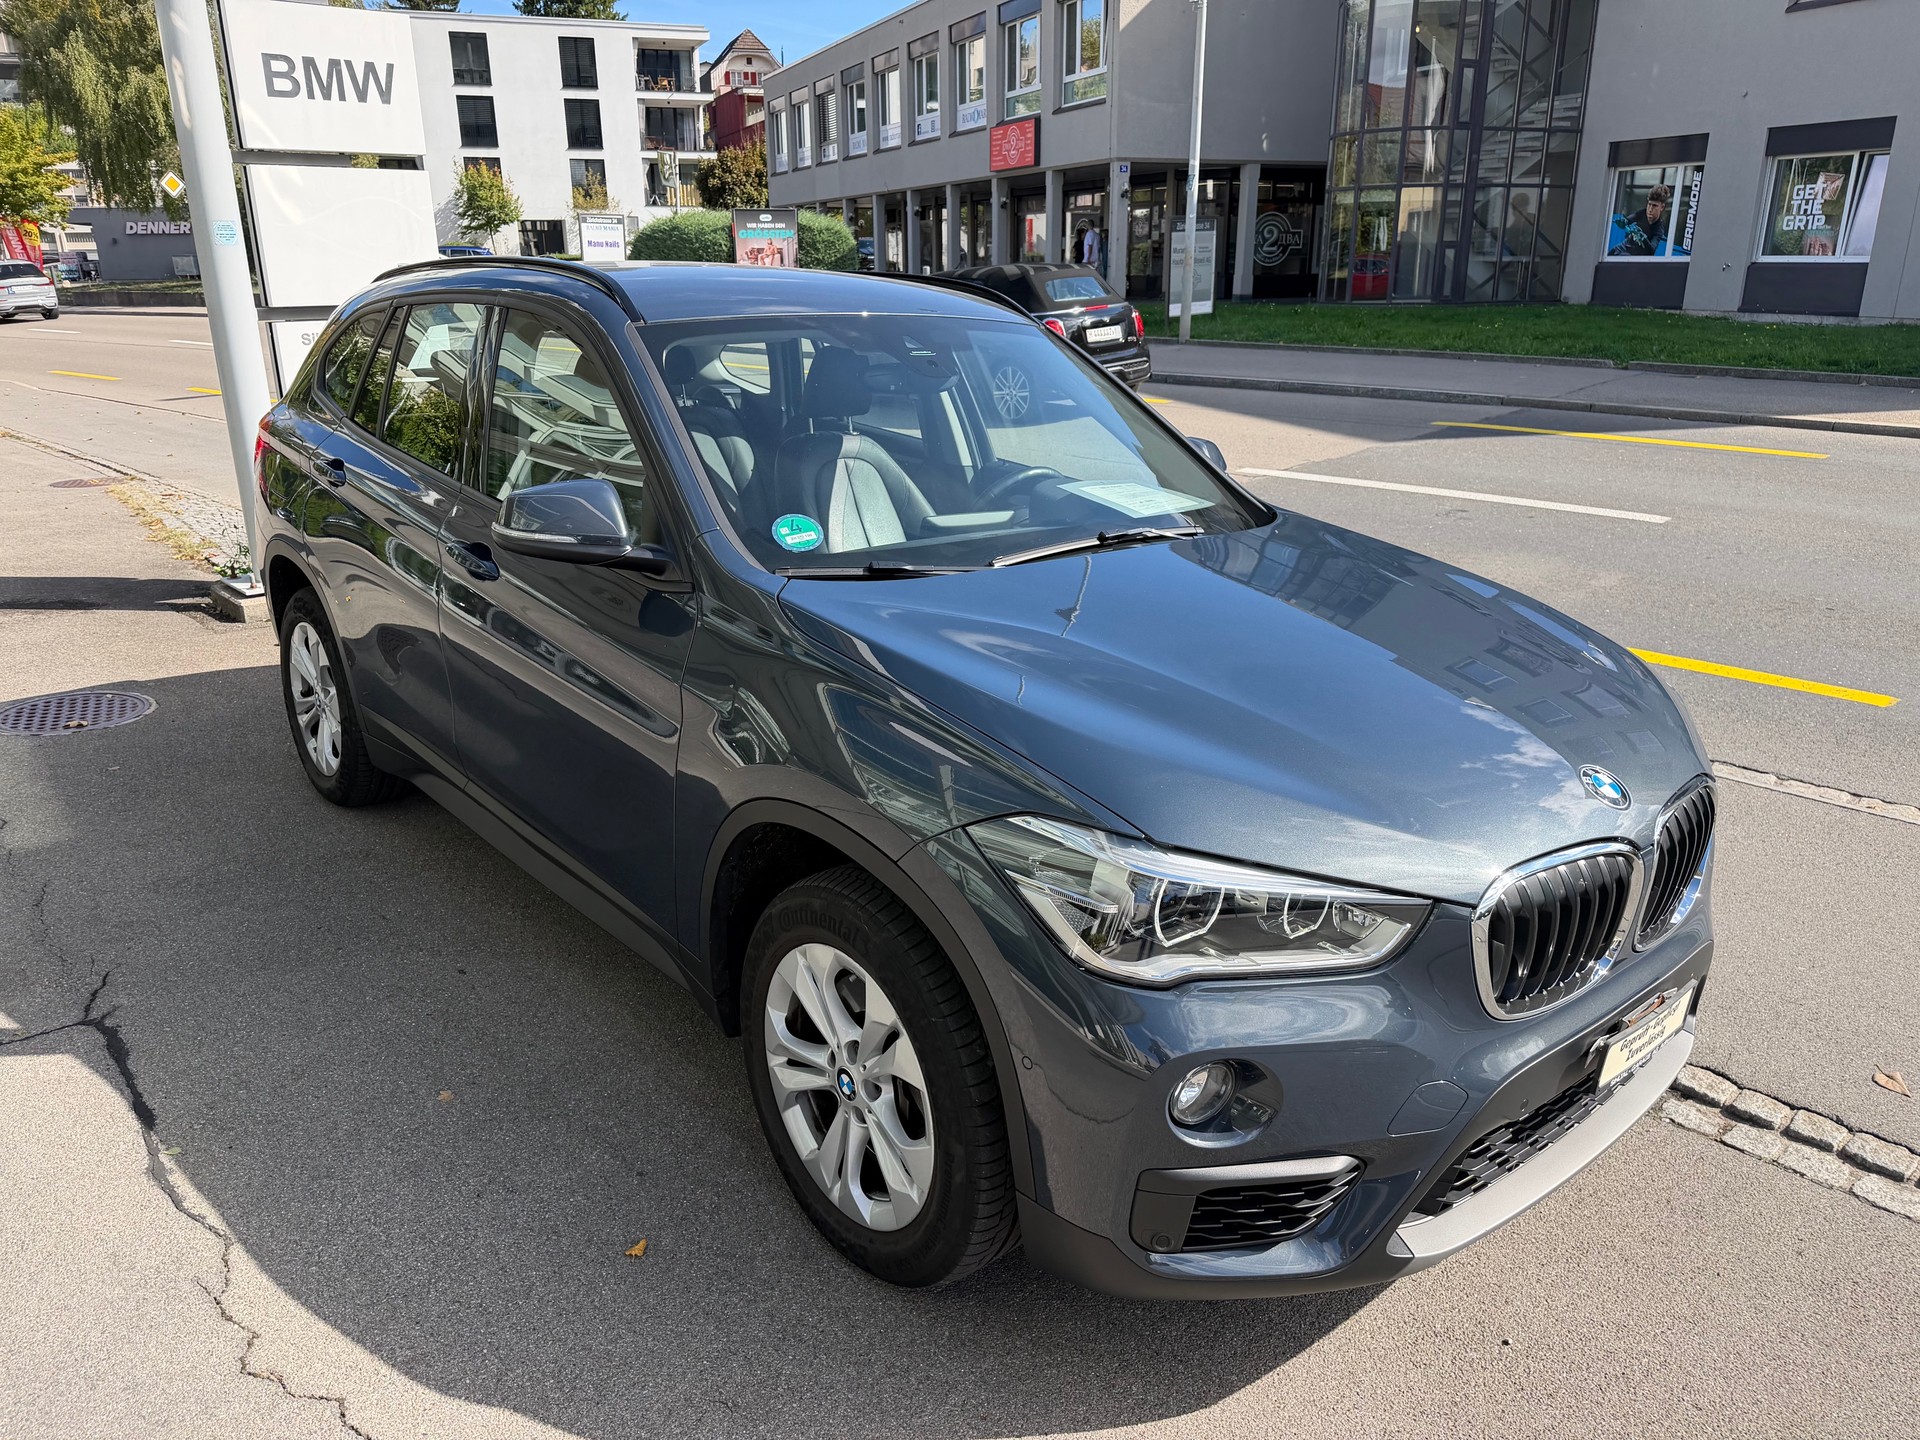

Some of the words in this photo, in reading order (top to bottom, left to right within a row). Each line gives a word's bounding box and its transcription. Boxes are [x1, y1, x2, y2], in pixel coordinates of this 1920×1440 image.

[261, 52, 394, 105] BMW
[1792, 184, 1827, 200] GET
[1682, 170, 1702, 251] GRIPMODE
[1791, 200, 1824, 215] THE
[22, 228, 39, 240] 20%
[125, 221, 191, 235] DENNER
[1262, 225, 1278, 251] 2
[301, 332, 319, 346] Si
[791, 519, 802, 532] 4
[778, 905, 860, 945] Continental
